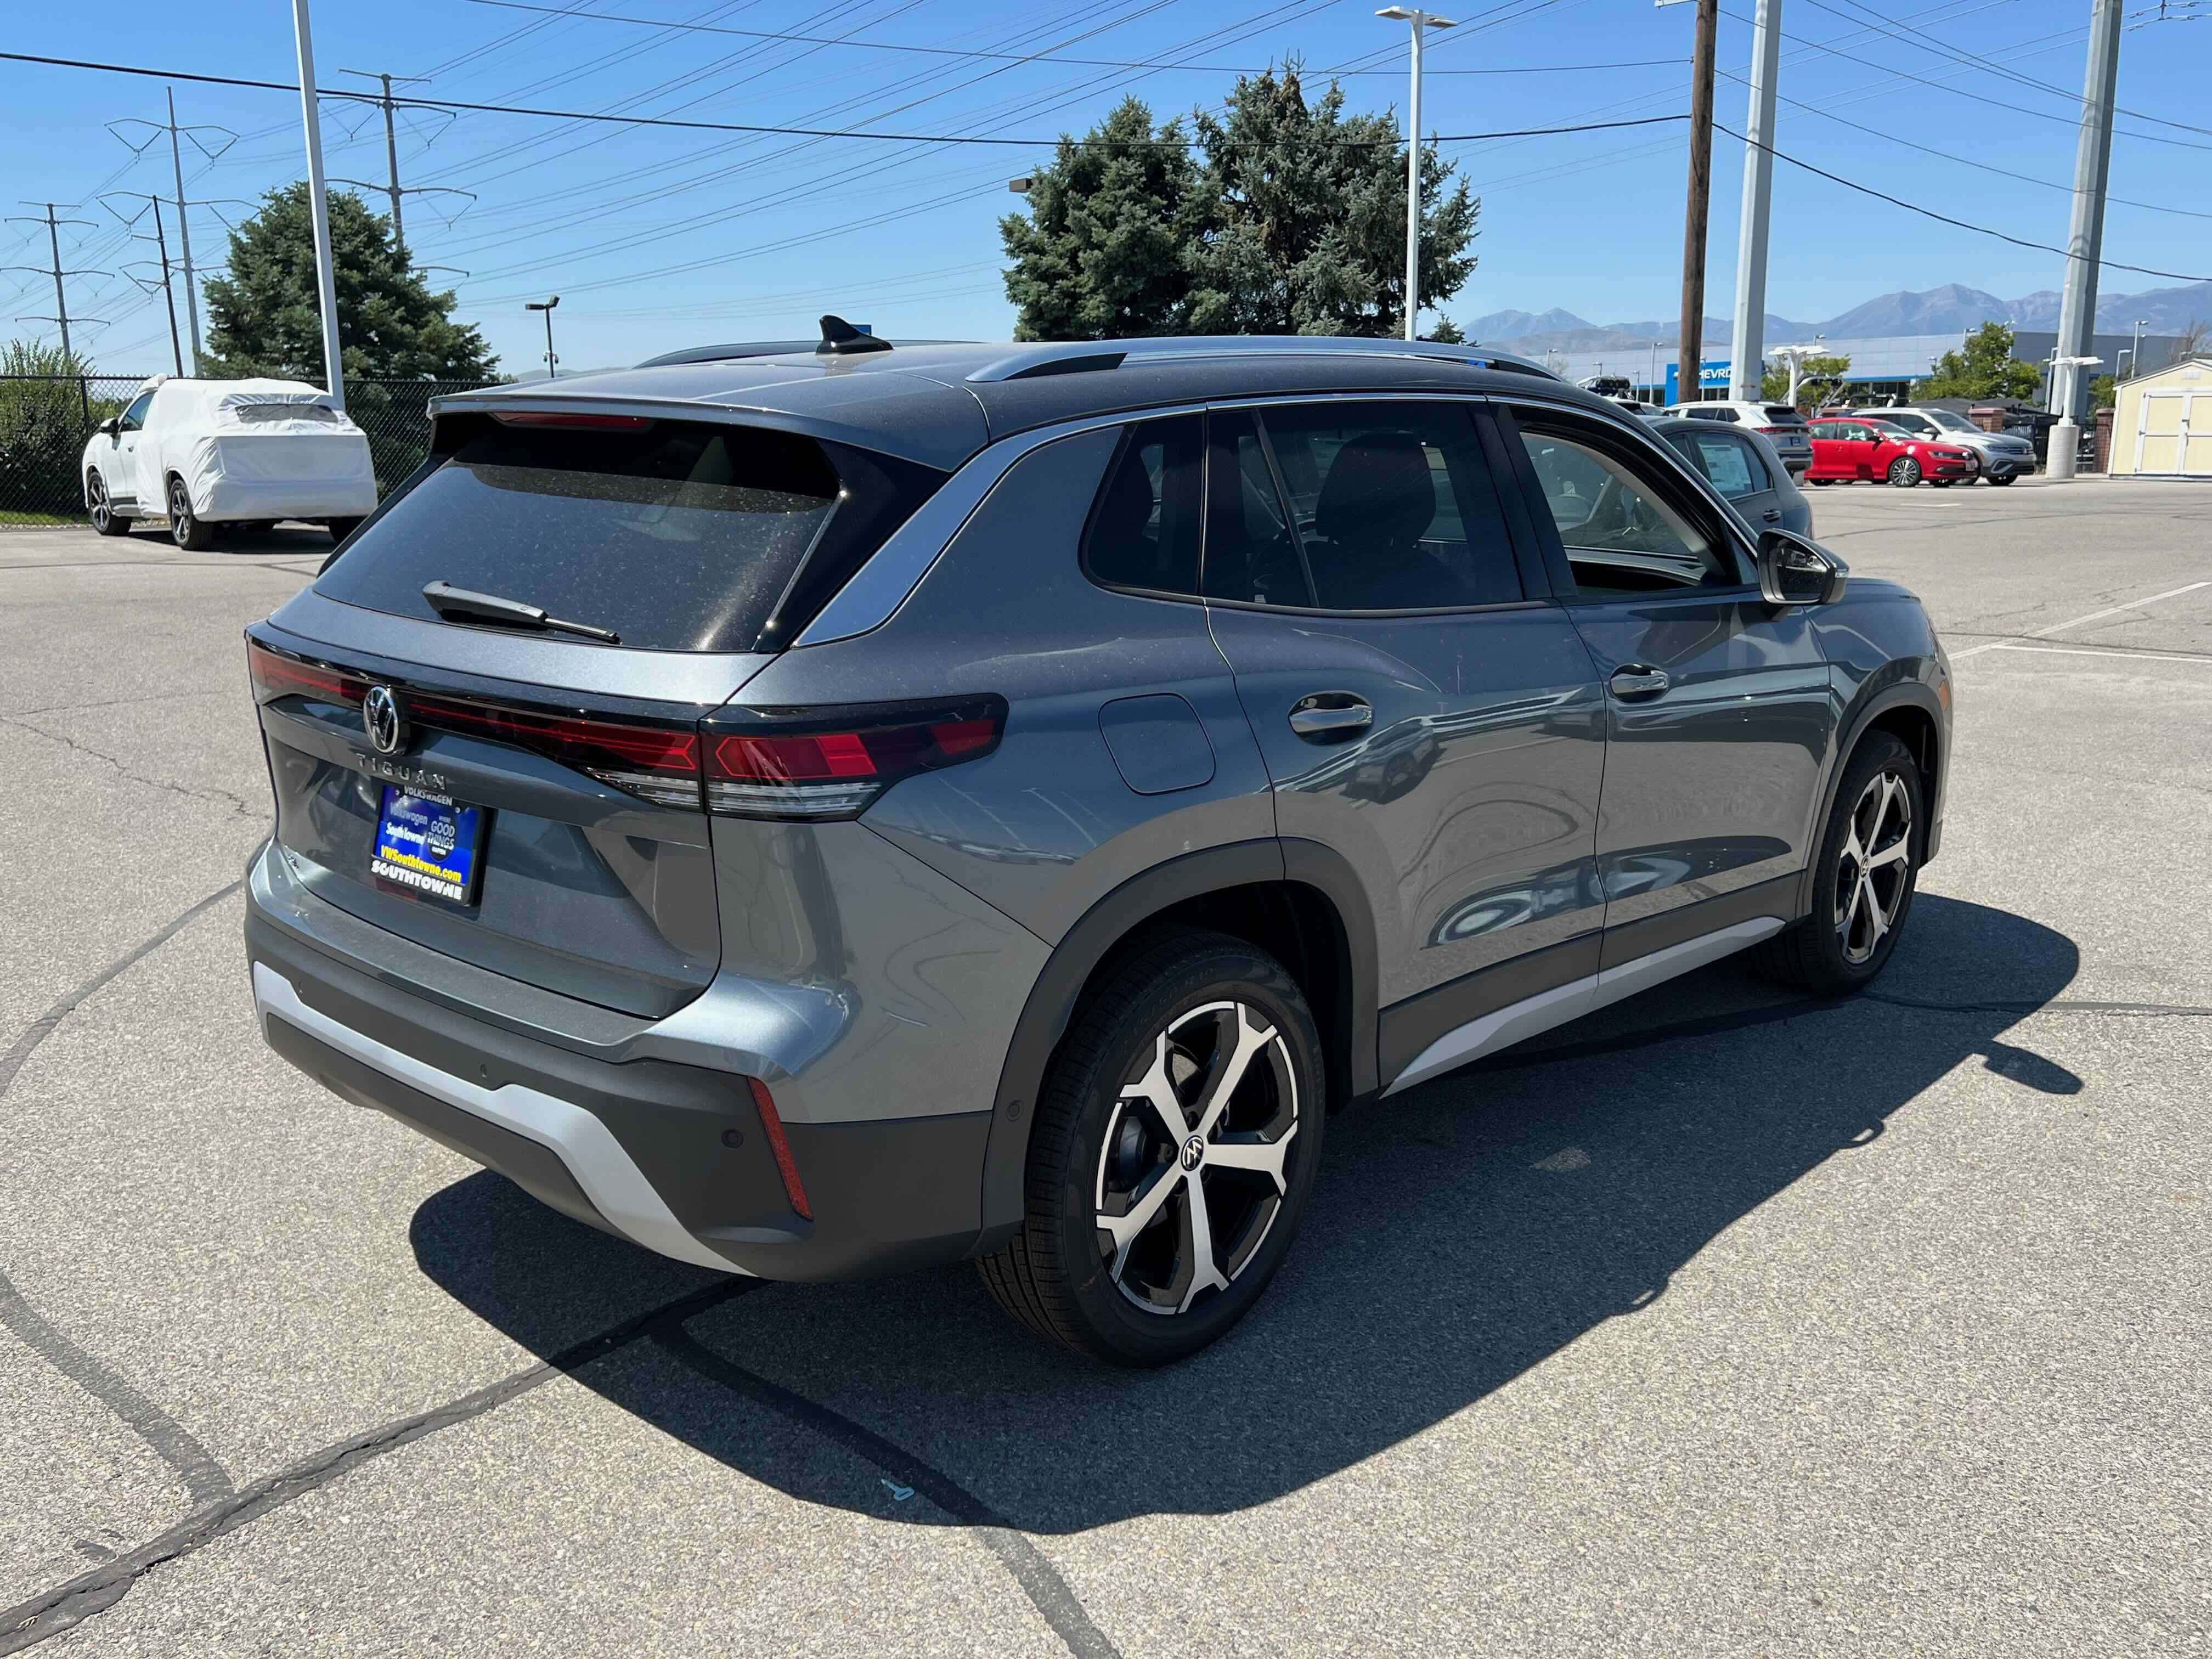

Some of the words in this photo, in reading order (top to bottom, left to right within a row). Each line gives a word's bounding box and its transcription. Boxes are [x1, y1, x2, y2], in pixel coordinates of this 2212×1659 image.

[356, 753, 446, 791] TIGUAN
[404, 785, 453, 806] VOLKSWAGEN
[431, 820, 455, 837] GOOD
[427, 831, 455, 850] THINGS
[371, 860, 462, 900] SOUTHTOWNE
